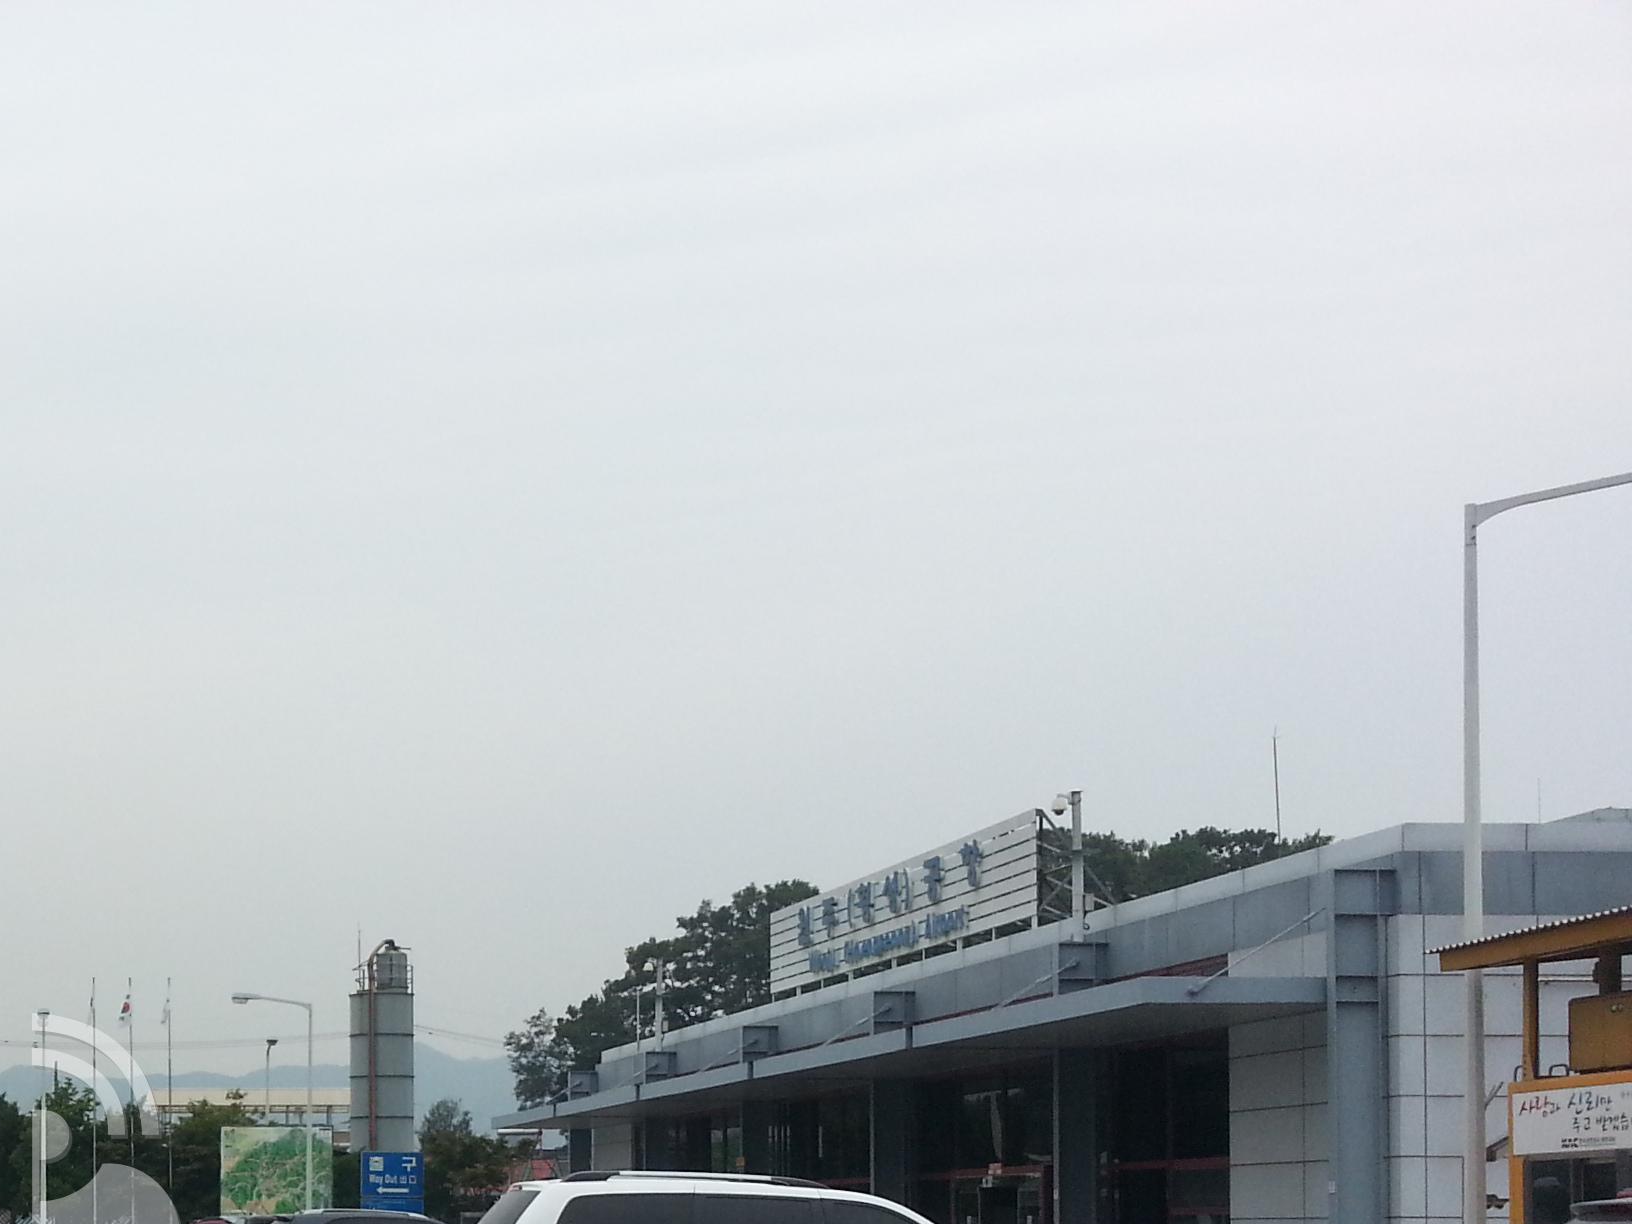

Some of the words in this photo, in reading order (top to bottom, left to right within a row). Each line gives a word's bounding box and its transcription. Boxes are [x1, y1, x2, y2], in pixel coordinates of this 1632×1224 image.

[1519, 1096, 1560, 1117] 사랑과
[1568, 1091, 1612, 1115] 신뢰만
[1572, 1117, 1591, 1133] 주고
[1596, 1112, 1632, 1131] 받겠습
